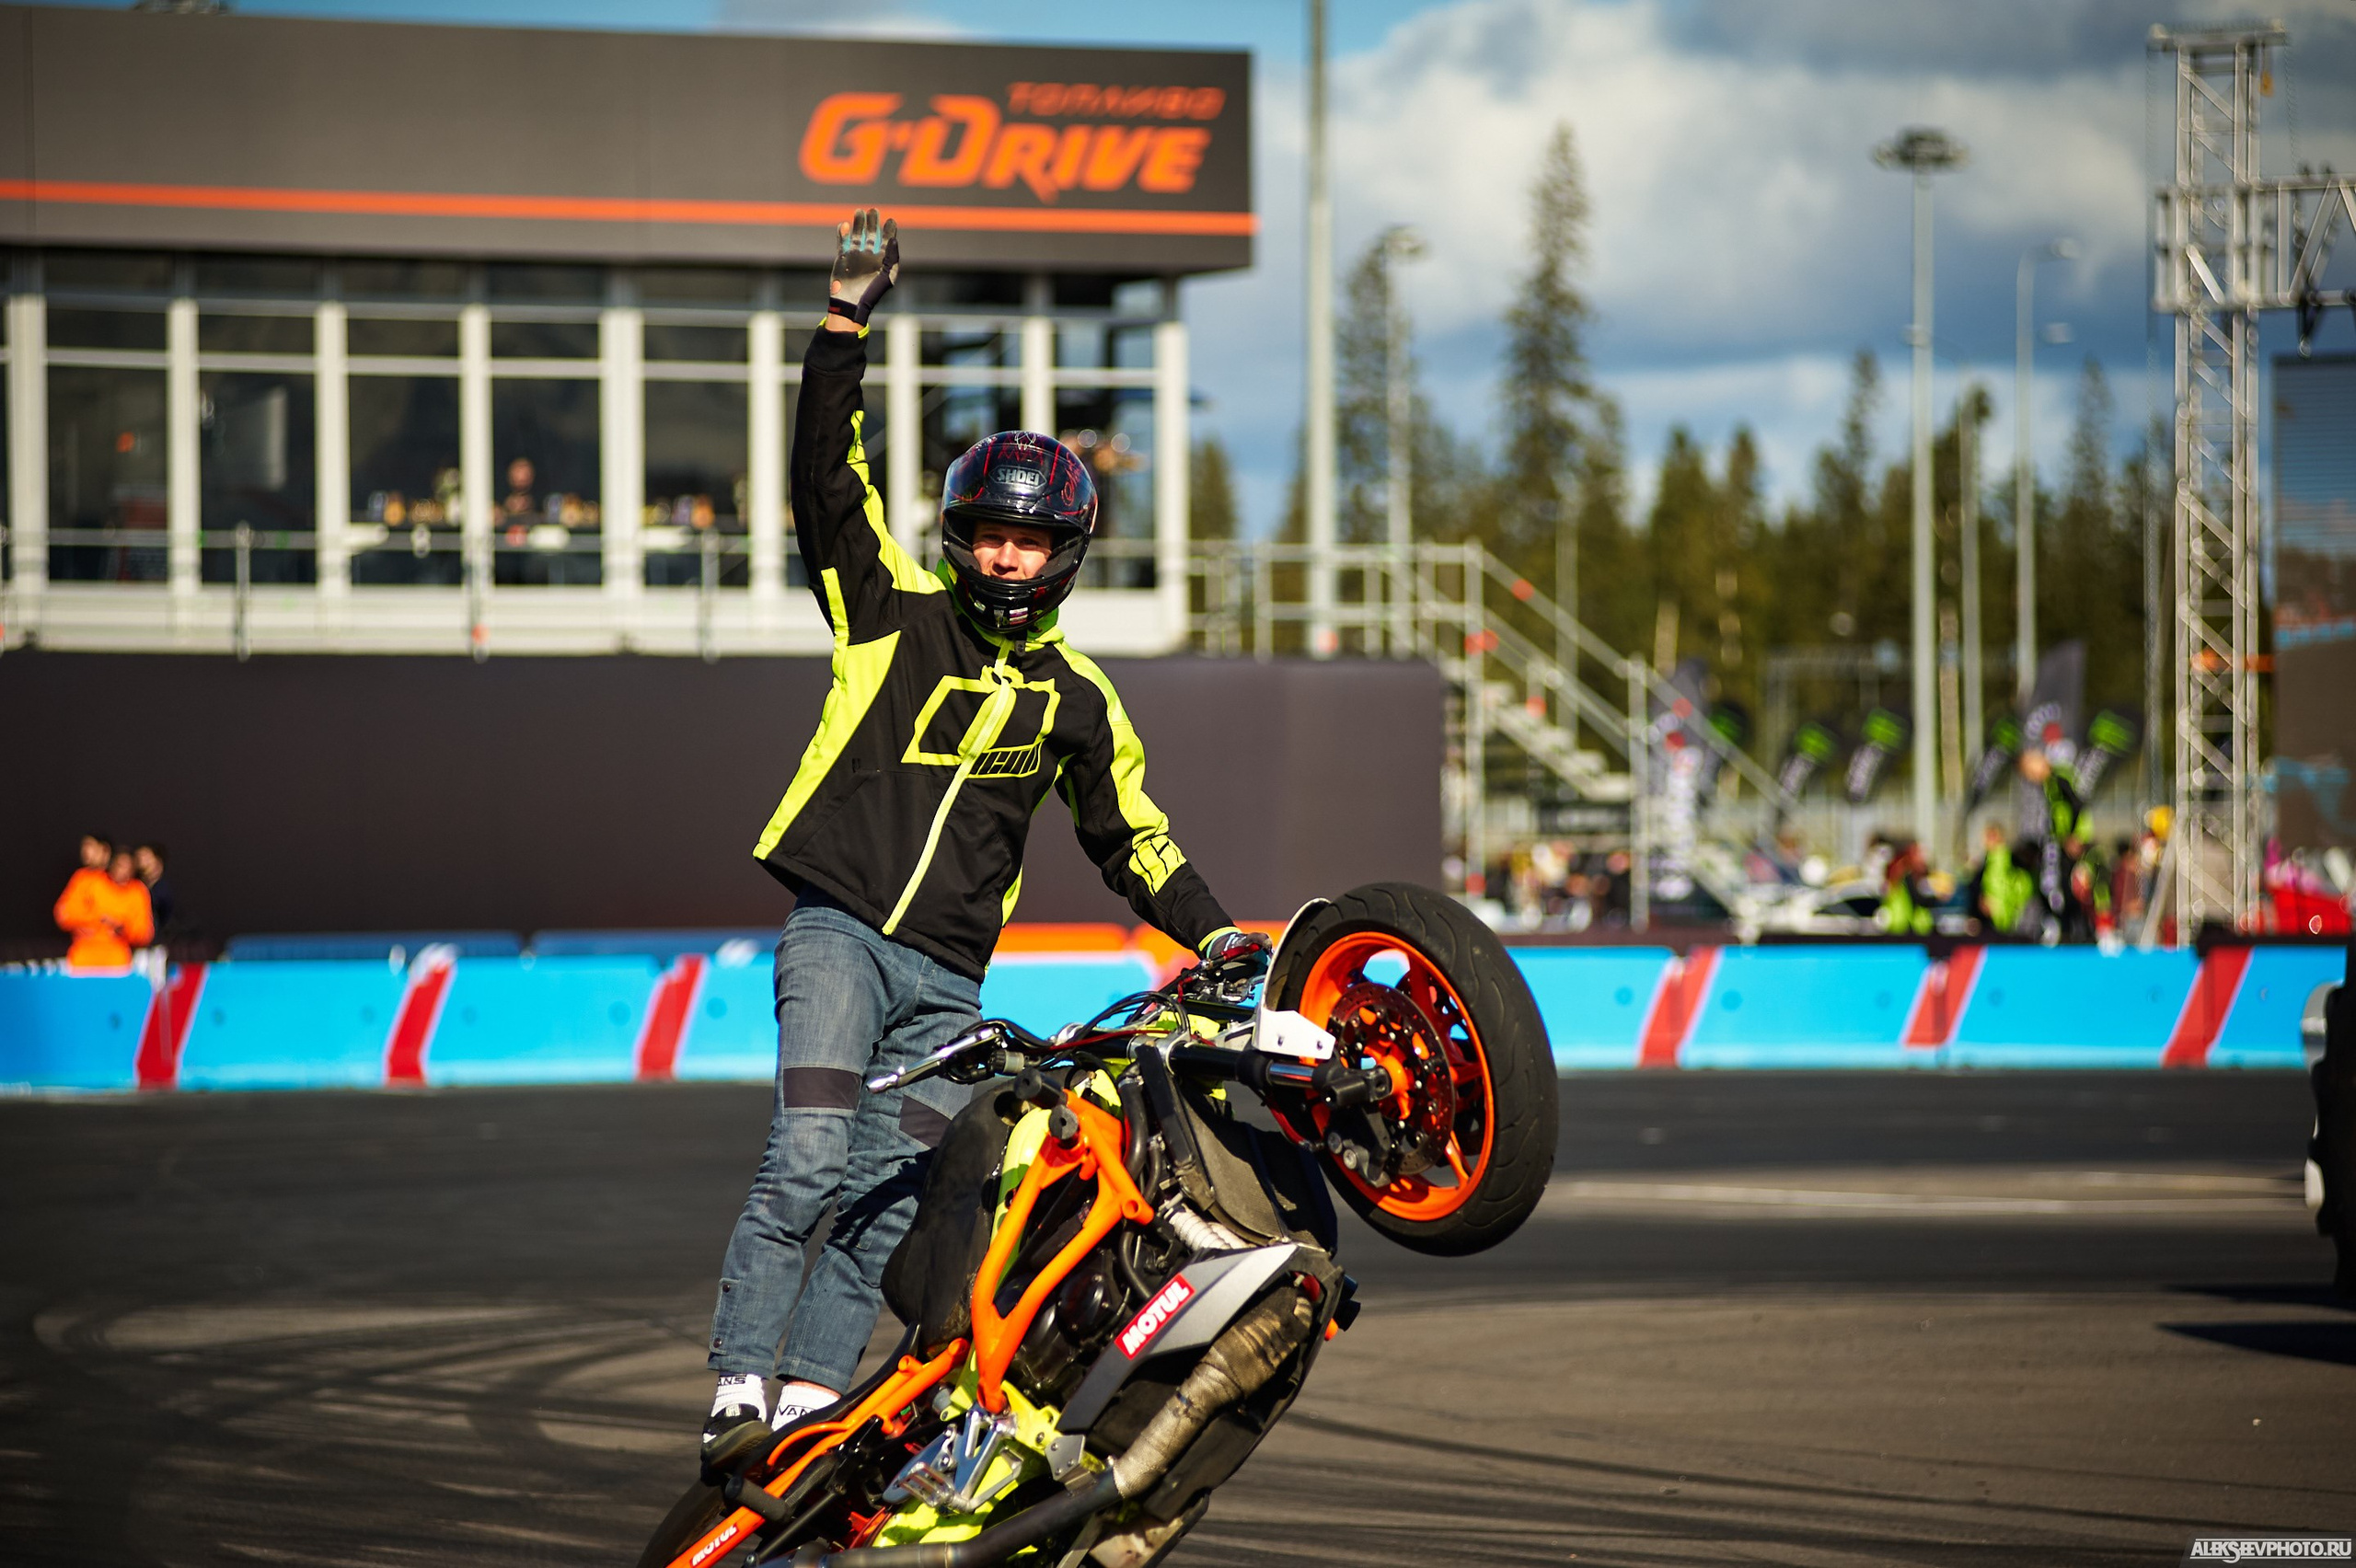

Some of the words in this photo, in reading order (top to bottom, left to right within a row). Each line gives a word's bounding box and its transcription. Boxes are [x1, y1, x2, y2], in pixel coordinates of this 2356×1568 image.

[997, 467, 1039, 486] SHOEI
[1122, 1281, 1190, 1355] MOTUL
[778, 1404, 815, 1417] VAN
[692, 1525, 737, 1566] MOTUL
